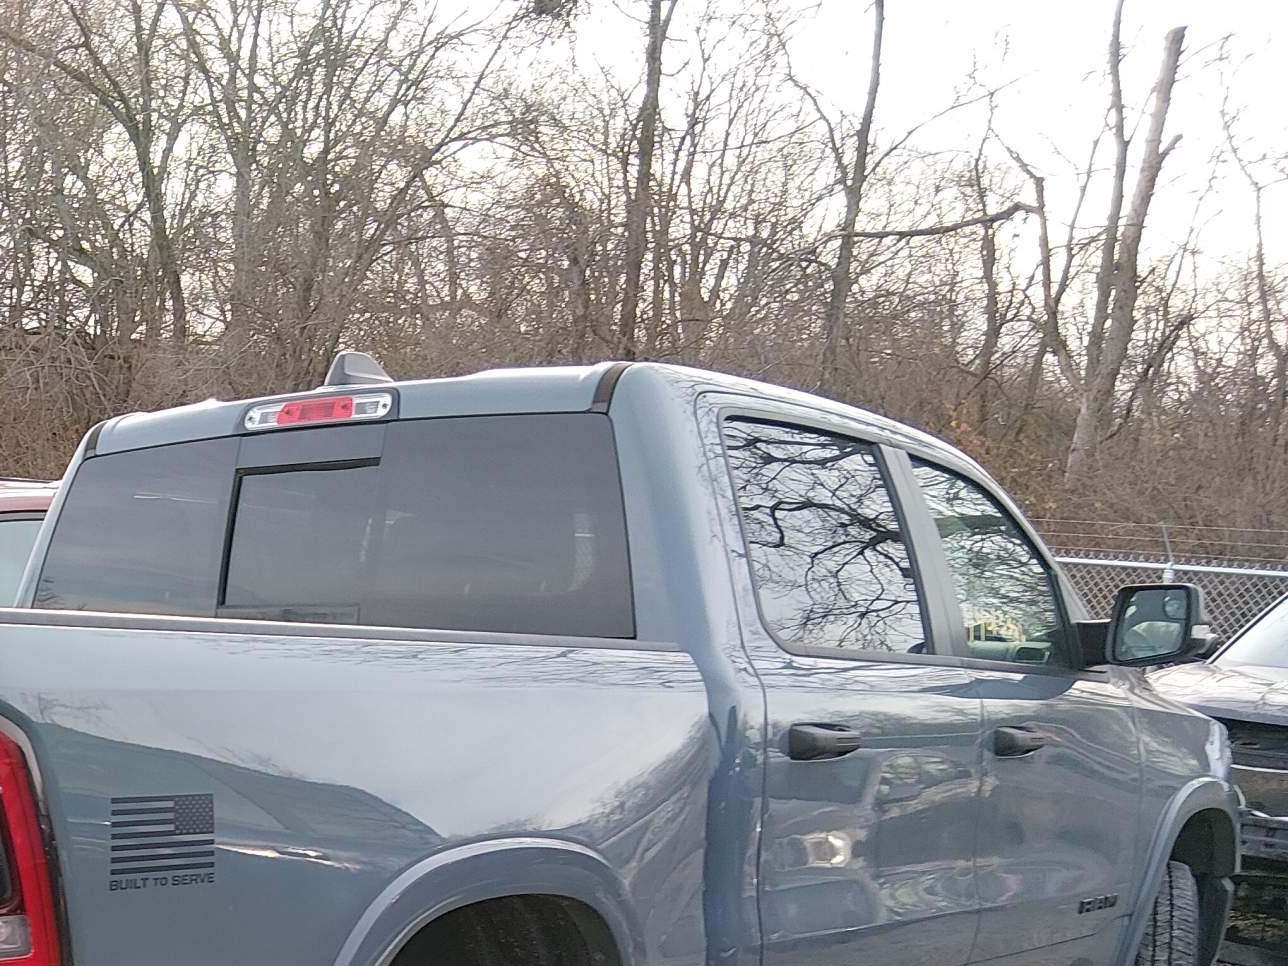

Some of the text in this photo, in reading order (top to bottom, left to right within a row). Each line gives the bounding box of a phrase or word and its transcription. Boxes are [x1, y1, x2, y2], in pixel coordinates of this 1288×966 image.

[109, 872, 215, 891] BUILT TO SERVE
